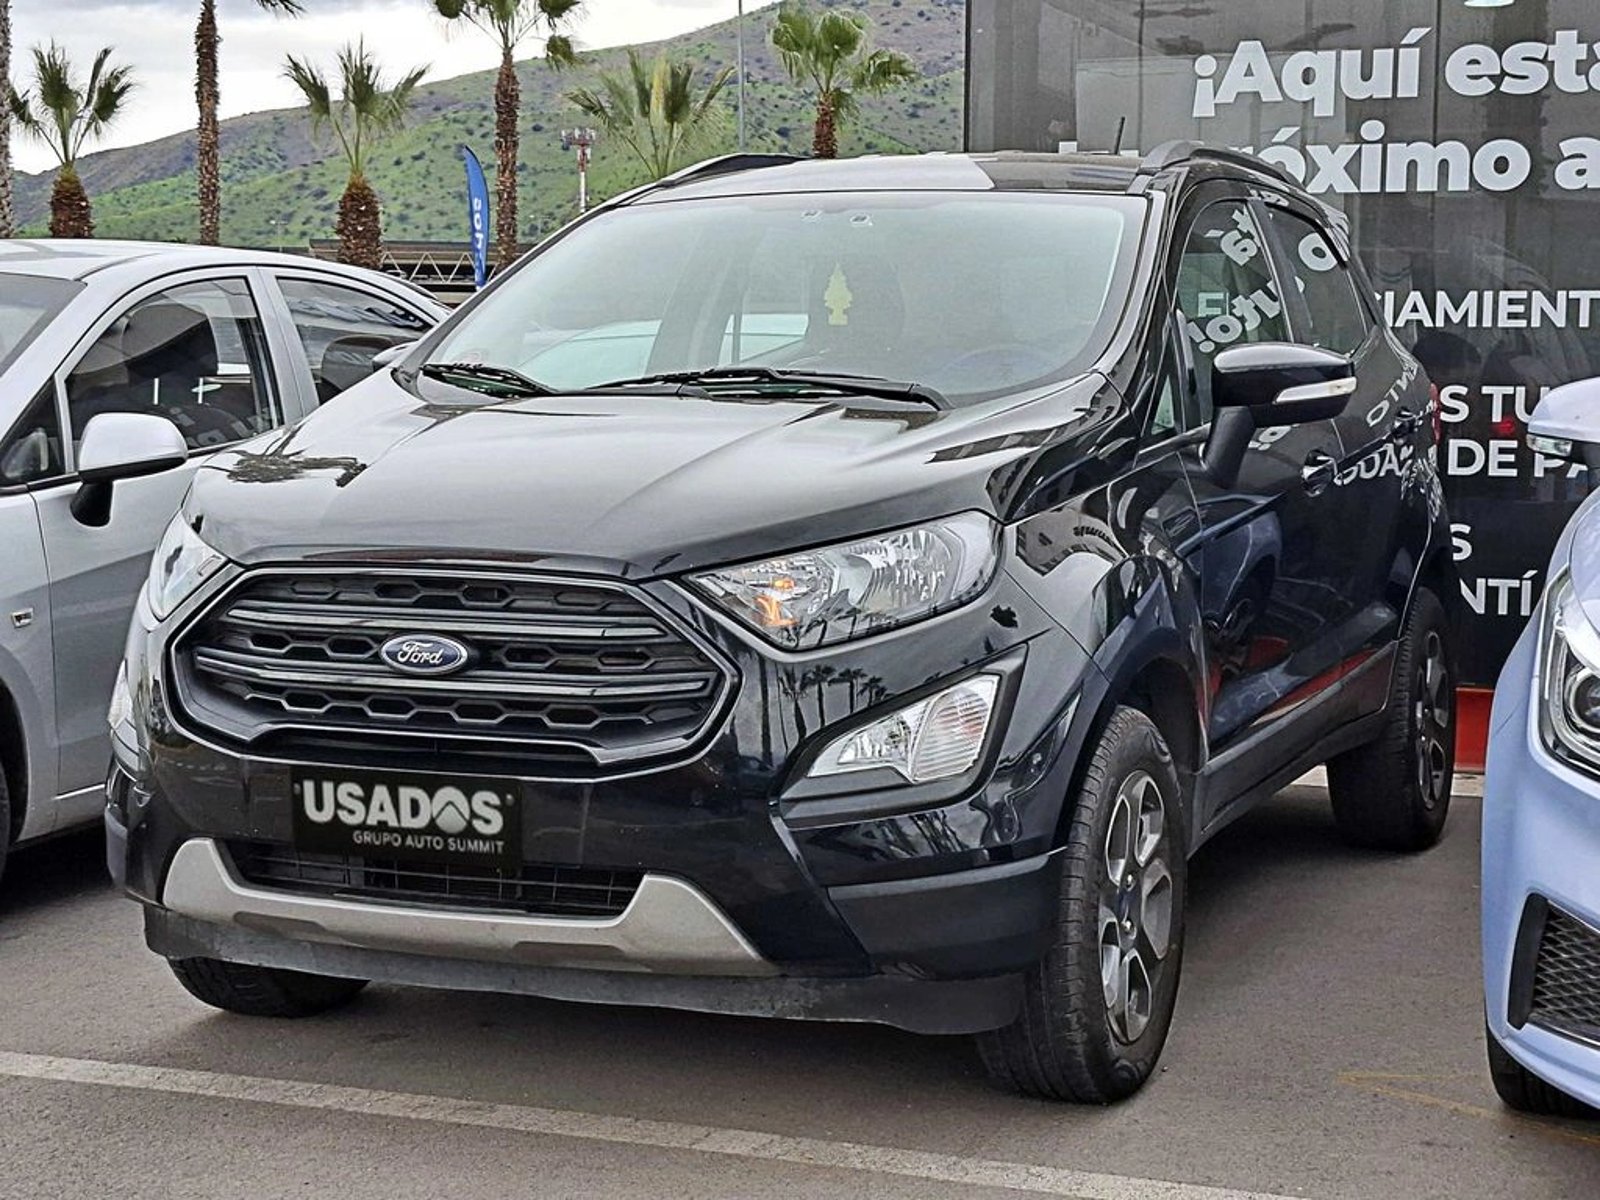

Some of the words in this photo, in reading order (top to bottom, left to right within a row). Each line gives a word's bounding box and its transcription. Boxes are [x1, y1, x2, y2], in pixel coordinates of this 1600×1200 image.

[1192, 27, 1432, 117] ¡Aquí
[1445, 29, 1600, 96] est
[1239, 120, 1531, 193] óximo
[1447, 438, 1518, 477] DE
[397, 640, 445, 665] Ford
[302, 779, 504, 836] USADOS
[352, 830, 401, 847] GRUPO
[404, 834, 444, 851] AUTO
[447, 838, 505, 855] SUMMIT
